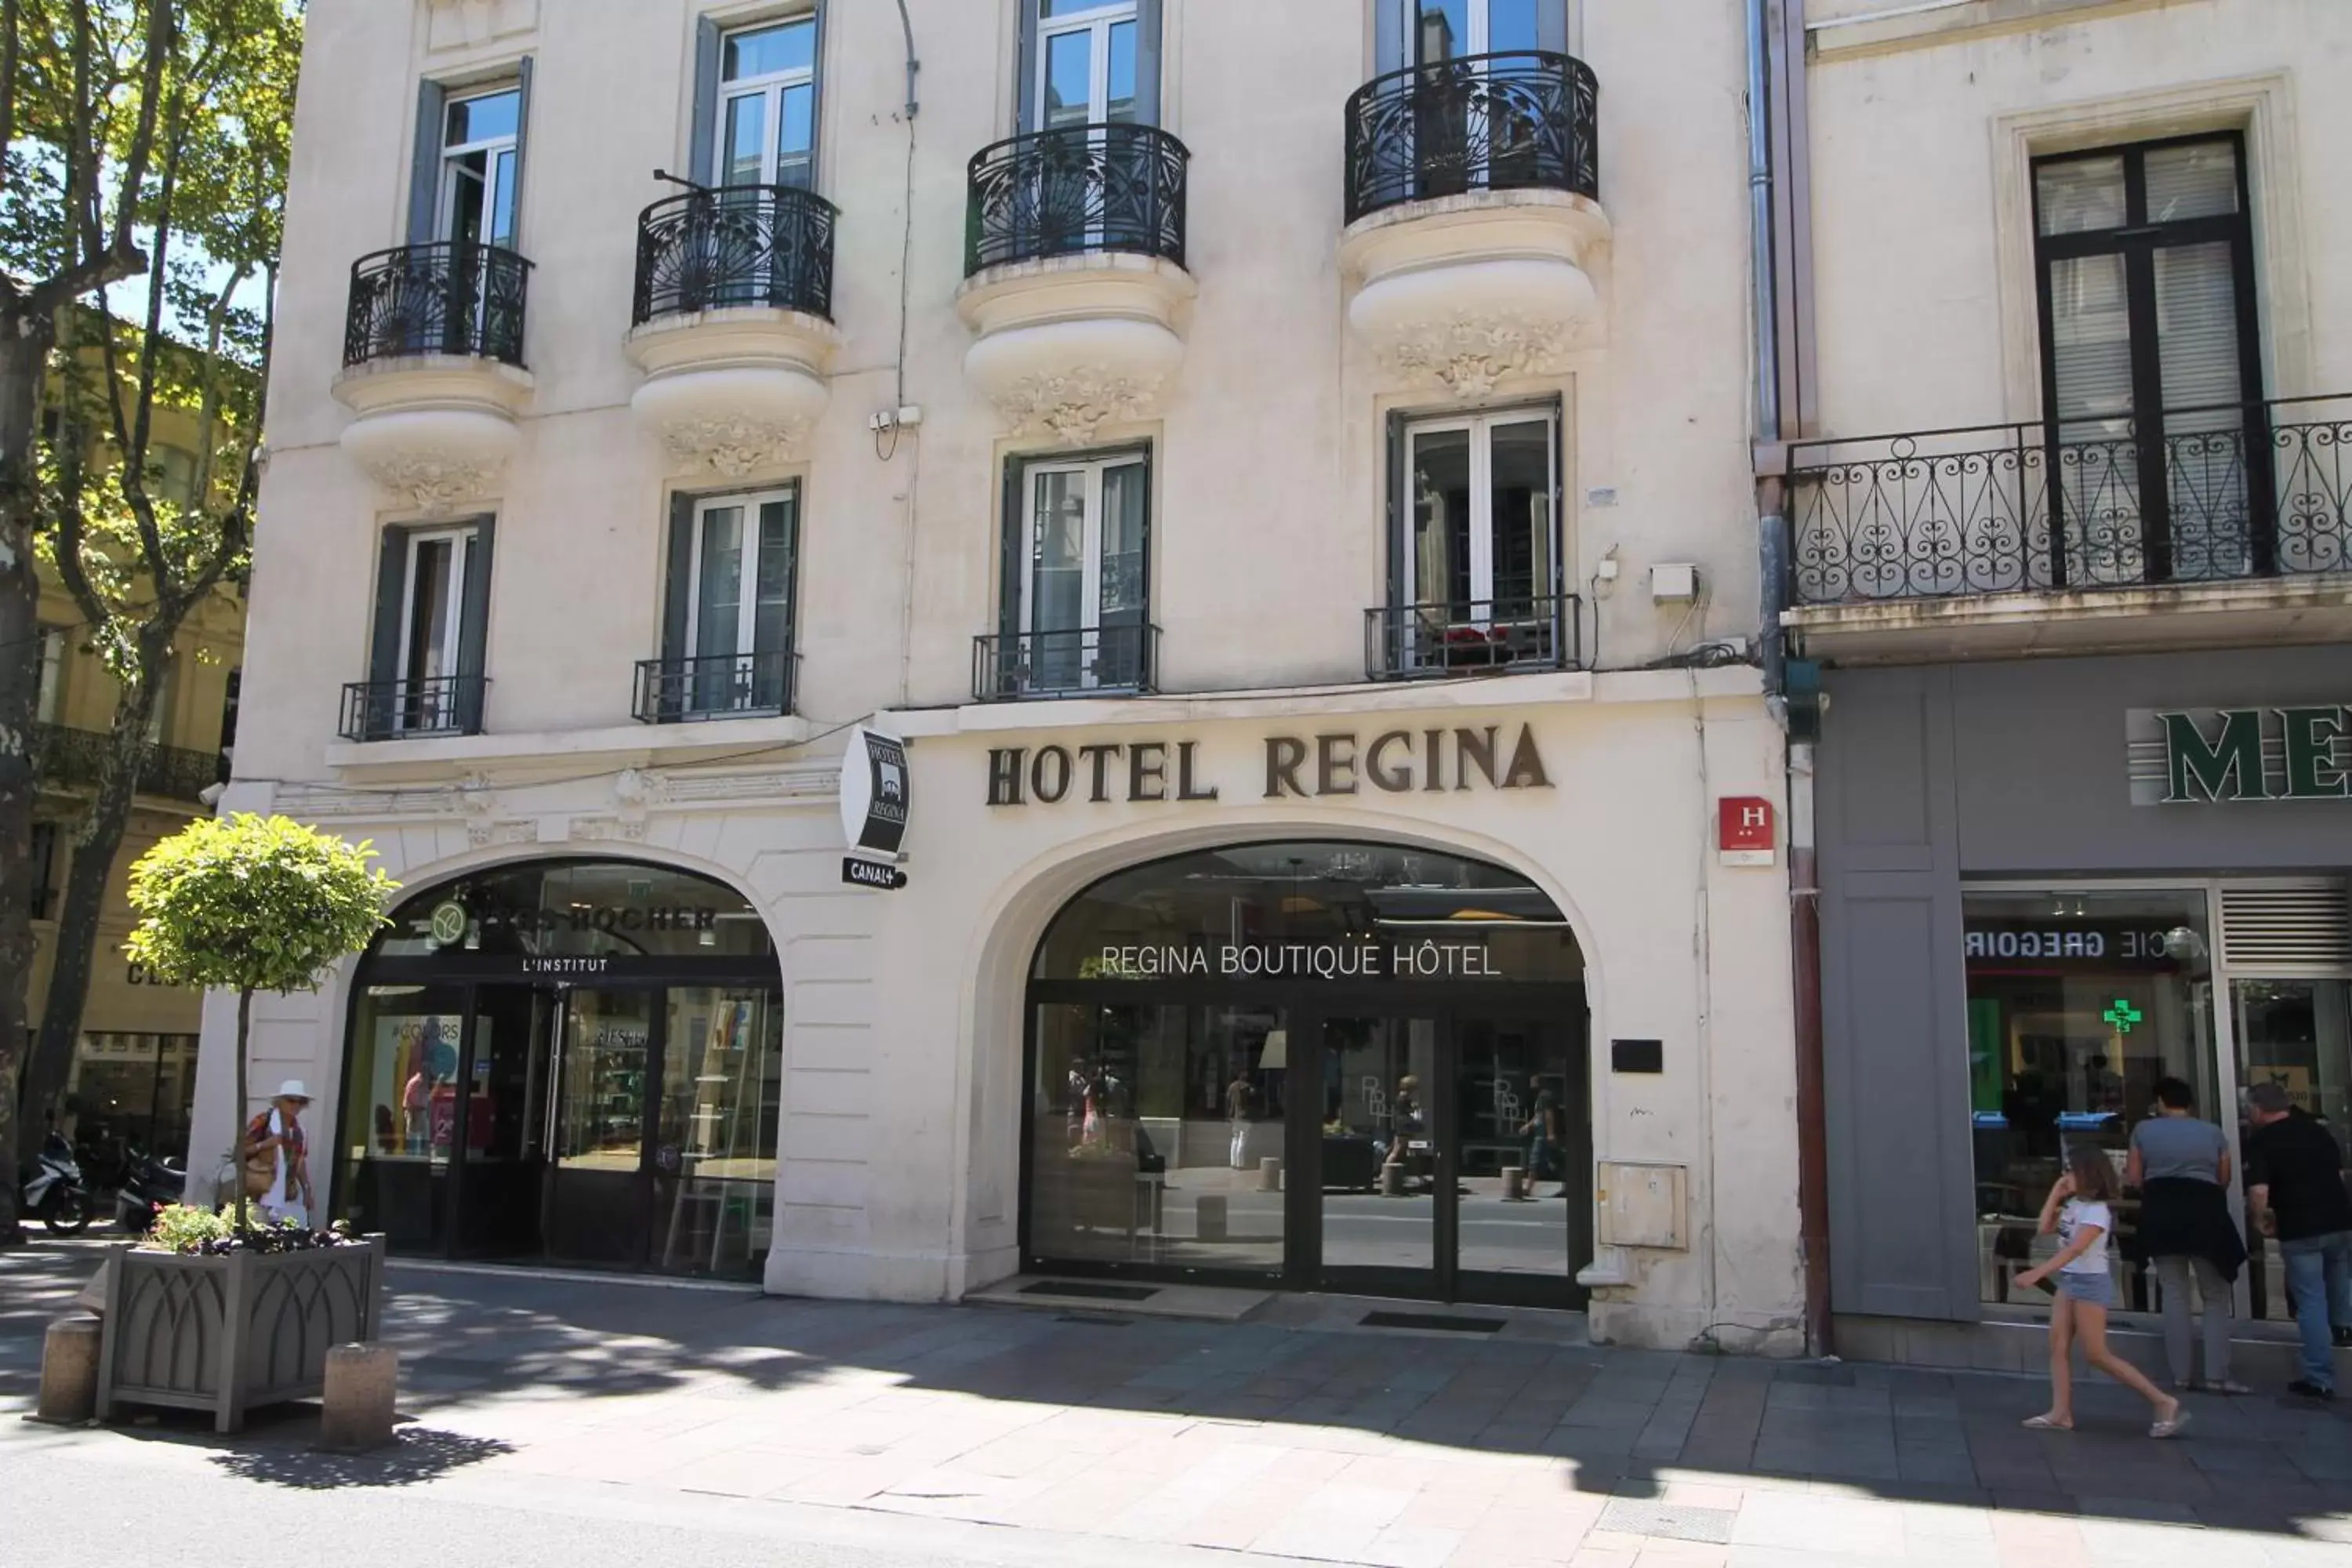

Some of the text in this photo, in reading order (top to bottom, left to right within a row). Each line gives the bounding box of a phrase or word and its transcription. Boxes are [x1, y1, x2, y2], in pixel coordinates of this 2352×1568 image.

[985, 722, 1556, 807] HOTEL REGINA
[2156, 706, 2352, 802] ME
[1743, 807, 1765, 827] H
[851, 862, 894, 884] CANAL+
[522, 959, 608, 972] L'INSTITUT
[1102, 939, 1501, 979] REGINA BOUTIQUE HÔTEL
